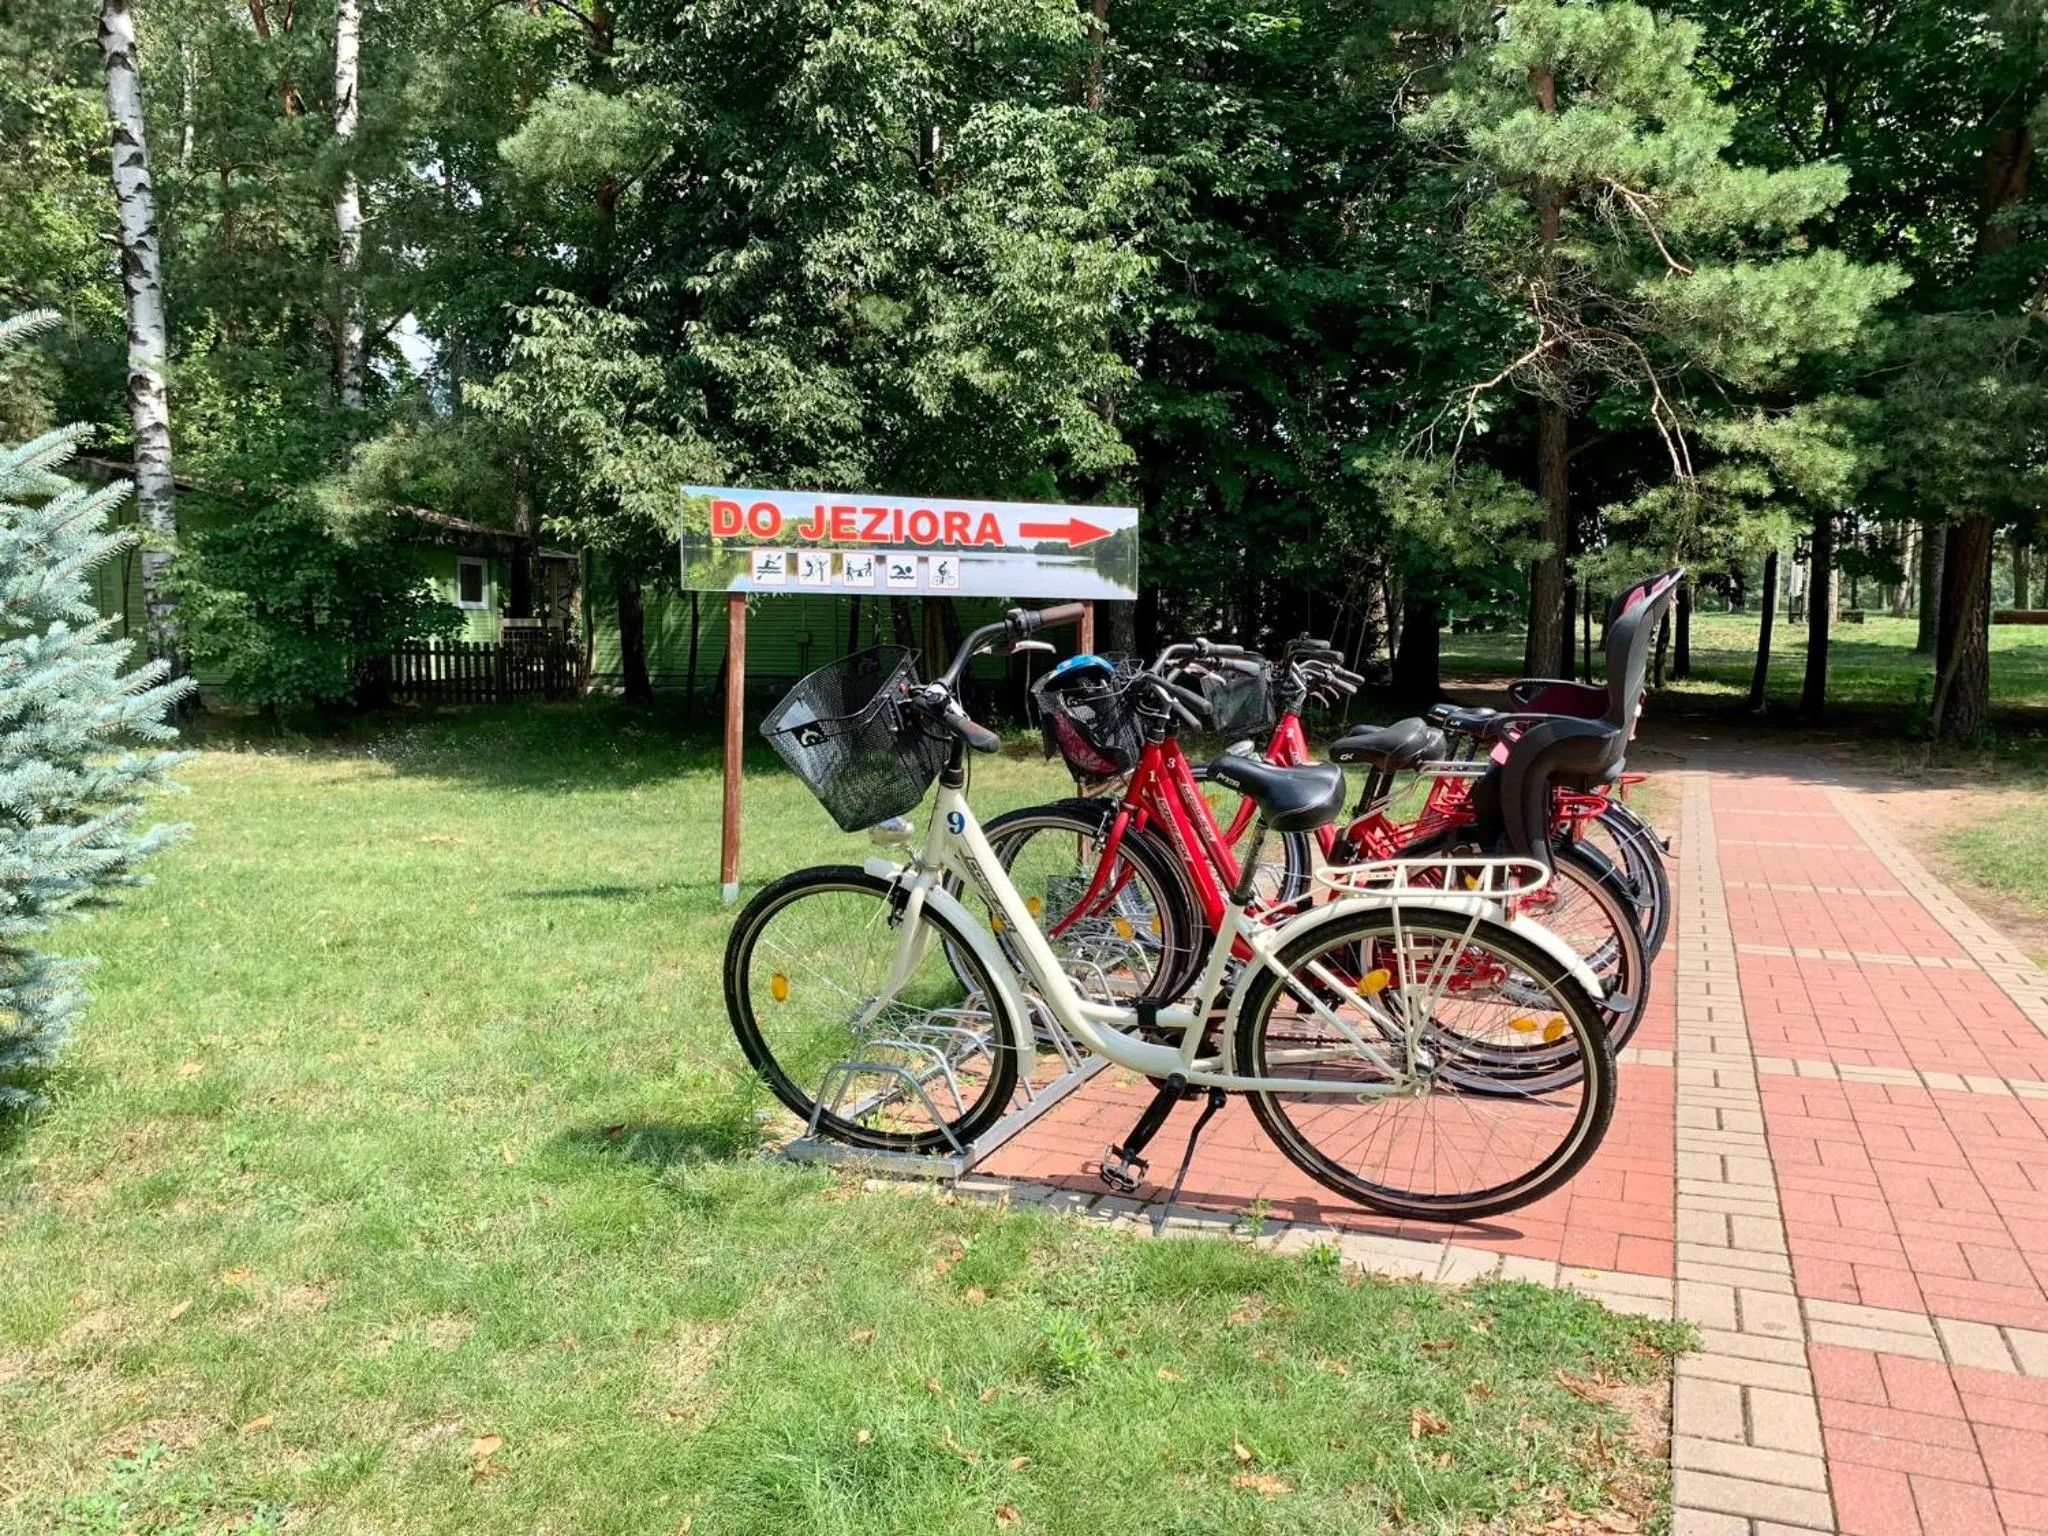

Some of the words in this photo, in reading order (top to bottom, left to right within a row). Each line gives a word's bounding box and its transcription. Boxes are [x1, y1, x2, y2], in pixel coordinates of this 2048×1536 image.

[711, 500, 781, 538] DO
[799, 504, 1004, 546] JEZIORA
[1166, 758, 1176, 769] 3
[1149, 770, 1157, 782] 1
[947, 811, 965, 835] 9
